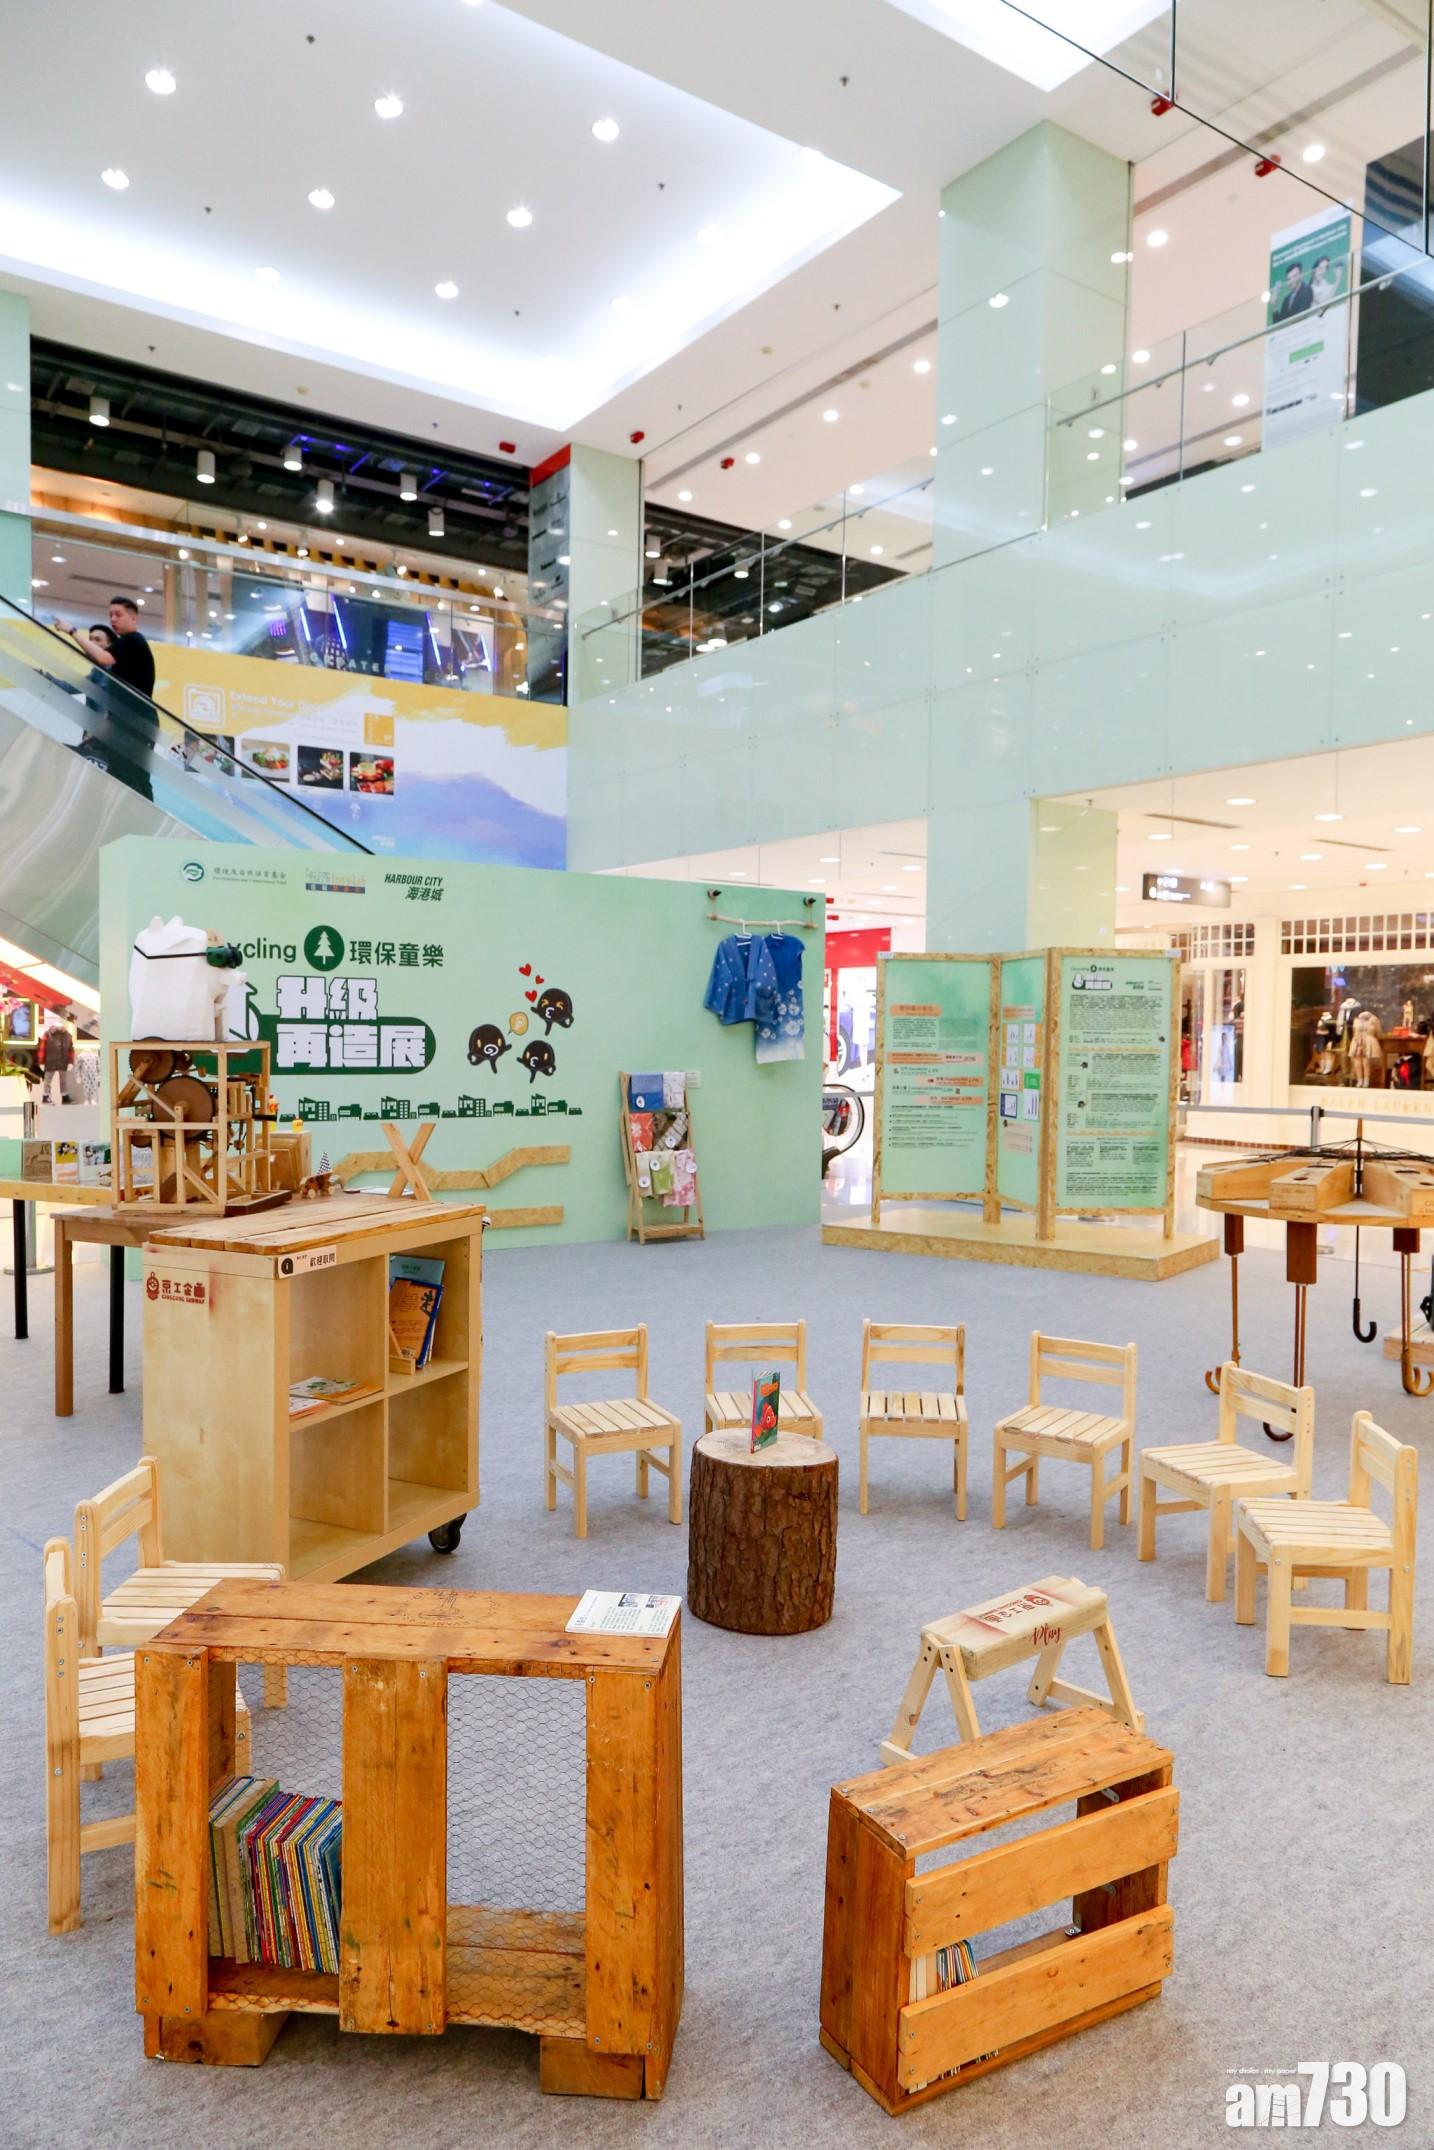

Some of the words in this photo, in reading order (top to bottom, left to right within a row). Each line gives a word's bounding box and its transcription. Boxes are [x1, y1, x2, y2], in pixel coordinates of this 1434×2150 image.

[384, 873, 422, 885] HARBOUR
[424, 875, 443, 887] CITY
[404, 886, 444, 902] 海港城
[349, 940, 444, 968] 環保童樂
[276, 975, 378, 1020] 升級
[276, 1023, 425, 1068] 再造展
[1032, 1622, 1061, 1646] Play
